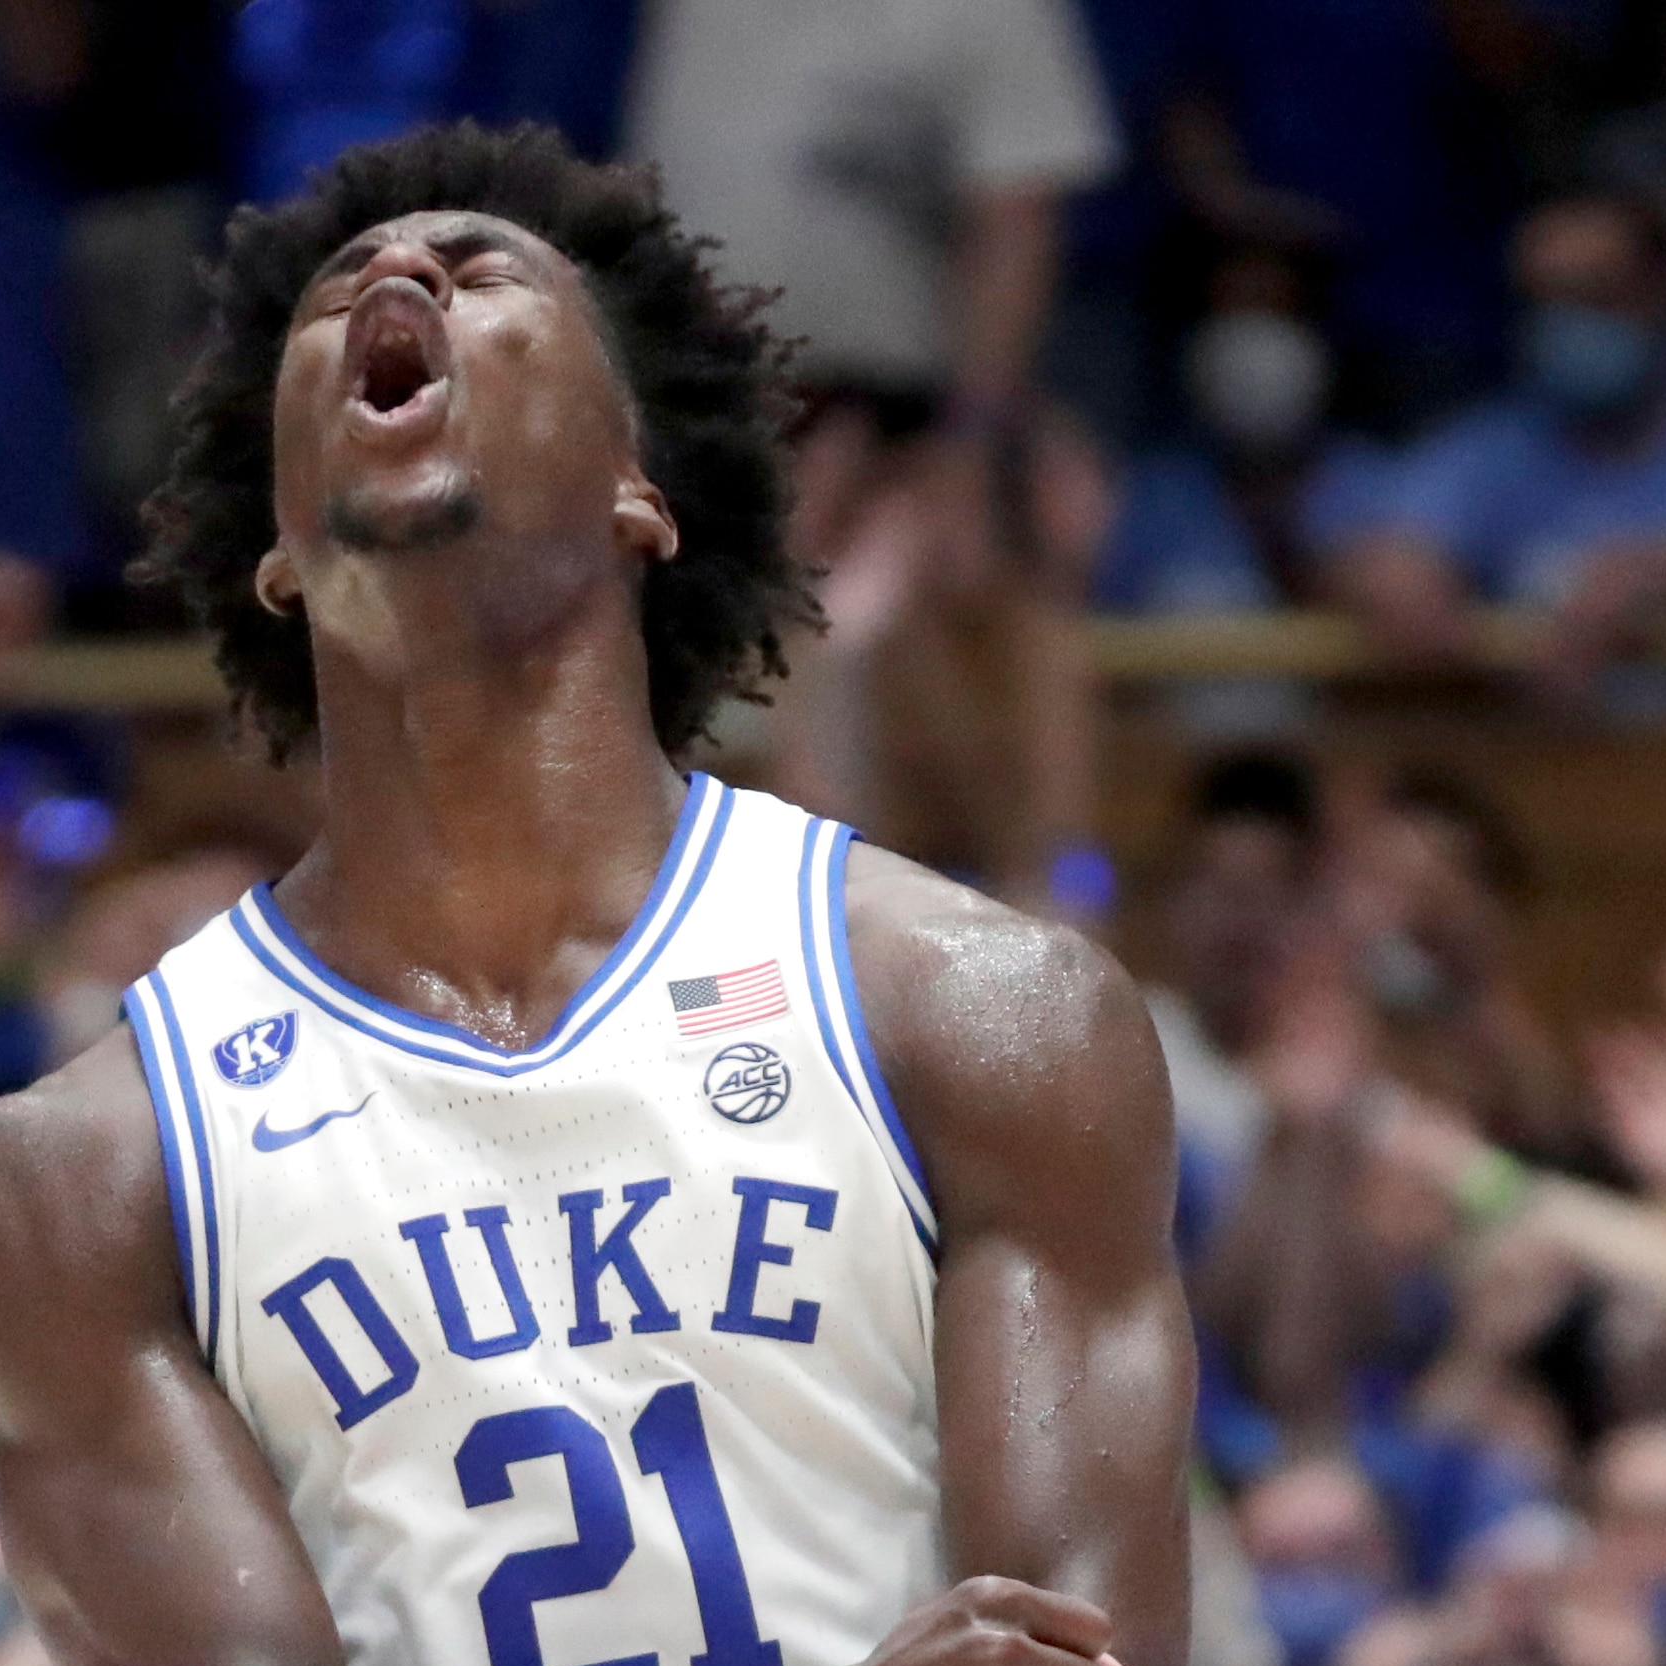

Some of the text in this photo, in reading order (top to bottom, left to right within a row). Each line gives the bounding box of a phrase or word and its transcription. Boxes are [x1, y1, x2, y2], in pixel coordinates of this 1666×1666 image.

[232, 1022, 281, 1076] K
[718, 1060, 782, 1092] ACC
[261, 1177, 838, 1432] DUKE
